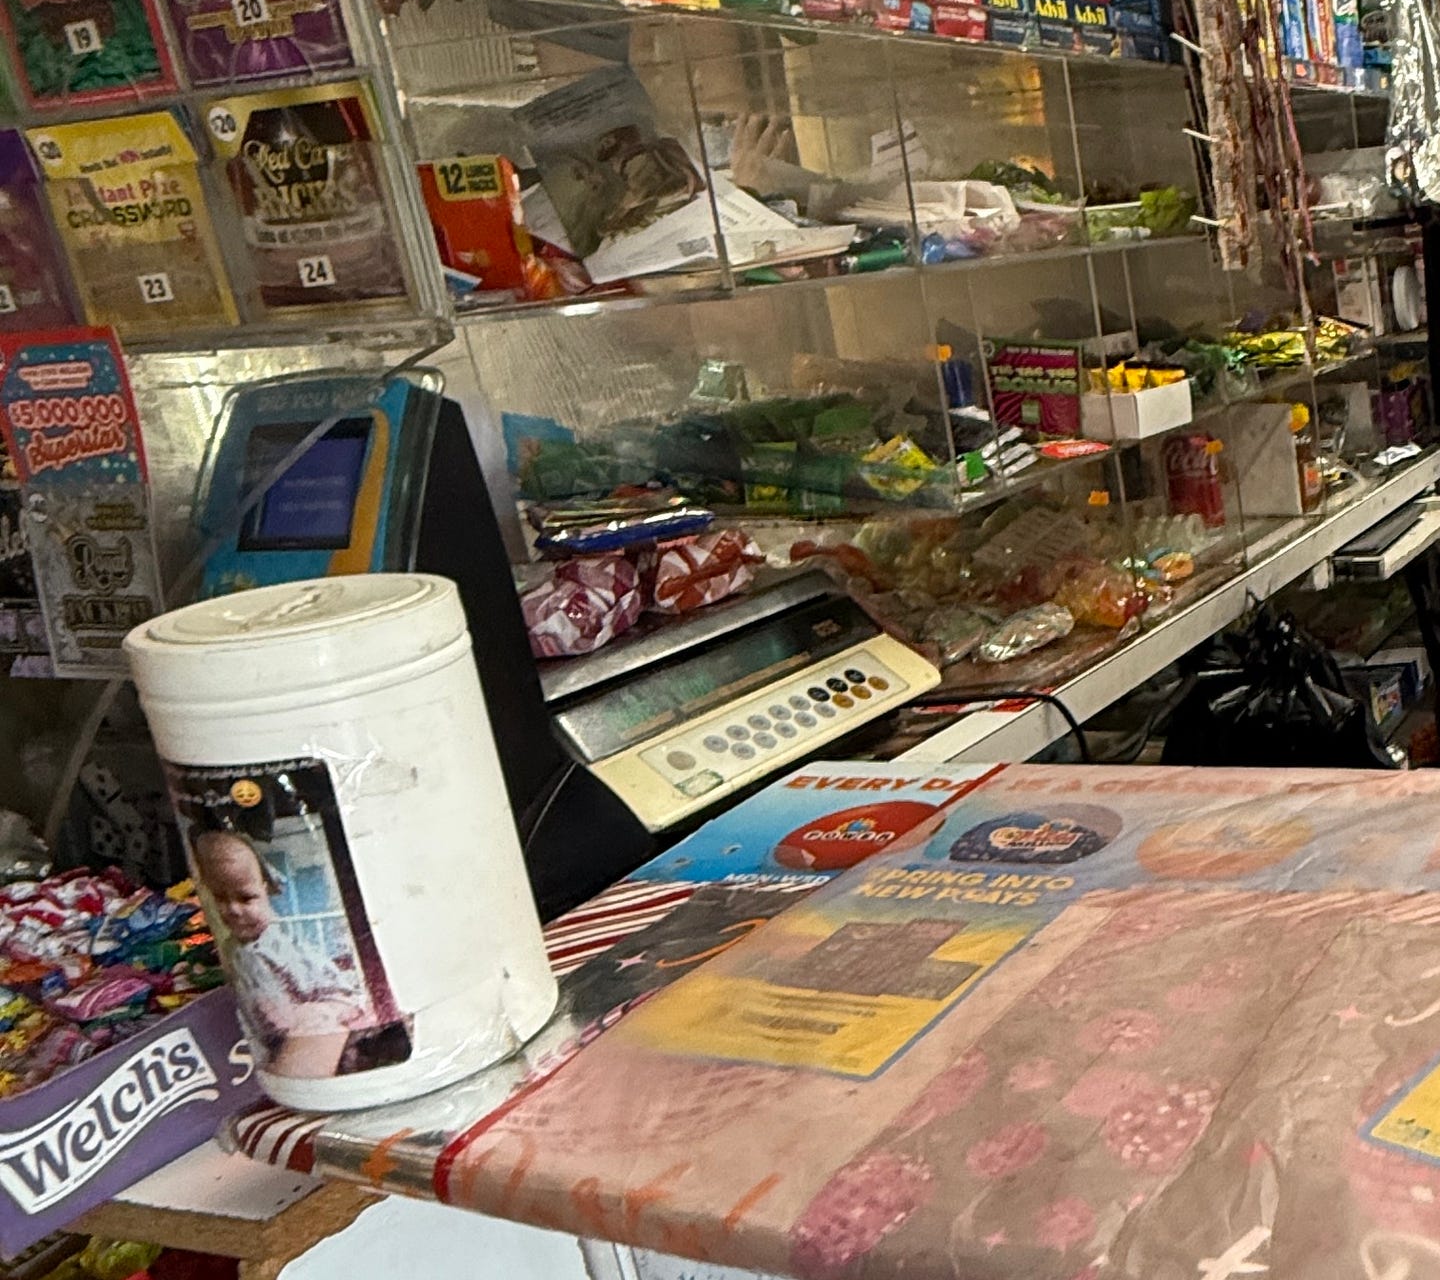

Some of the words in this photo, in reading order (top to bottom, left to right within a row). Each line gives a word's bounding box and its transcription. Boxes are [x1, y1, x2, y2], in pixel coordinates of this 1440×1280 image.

[1074, 3, 1108, 27] Advil
[72, 26, 91, 50] 19
[439, 162, 466, 194] 12
[303, 260, 328, 283] 24
[143, 277, 167, 299] 23
[784, 774, 918, 792] EVERY
[988, 873, 1076, 891] INTO
[3, 1043, 206, 1198] Welch's
